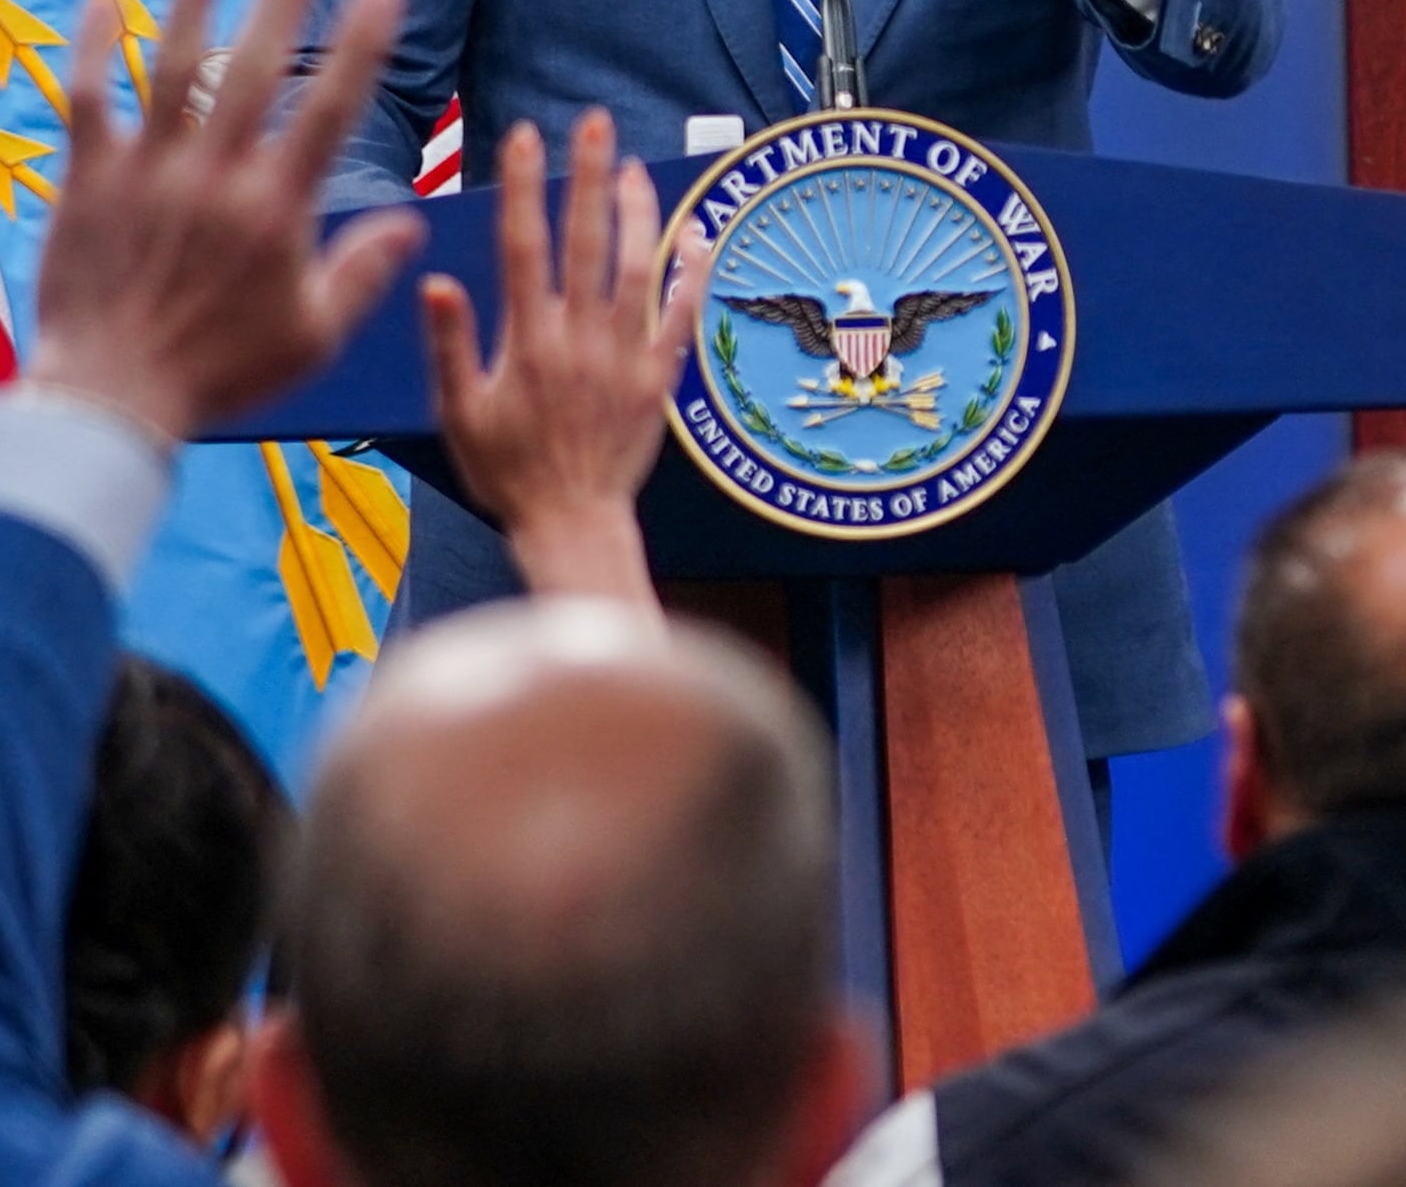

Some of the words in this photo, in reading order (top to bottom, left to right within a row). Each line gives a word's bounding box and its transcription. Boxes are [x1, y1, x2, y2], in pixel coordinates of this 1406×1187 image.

[926, 140, 988, 187] OF
[997, 192, 1059, 303] WAR
[687, 398, 775, 494] UNITED
[776, 485, 884, 522] STATES
[889, 487, 928, 518] OF
[936, 395, 1042, 504] AMERICA
